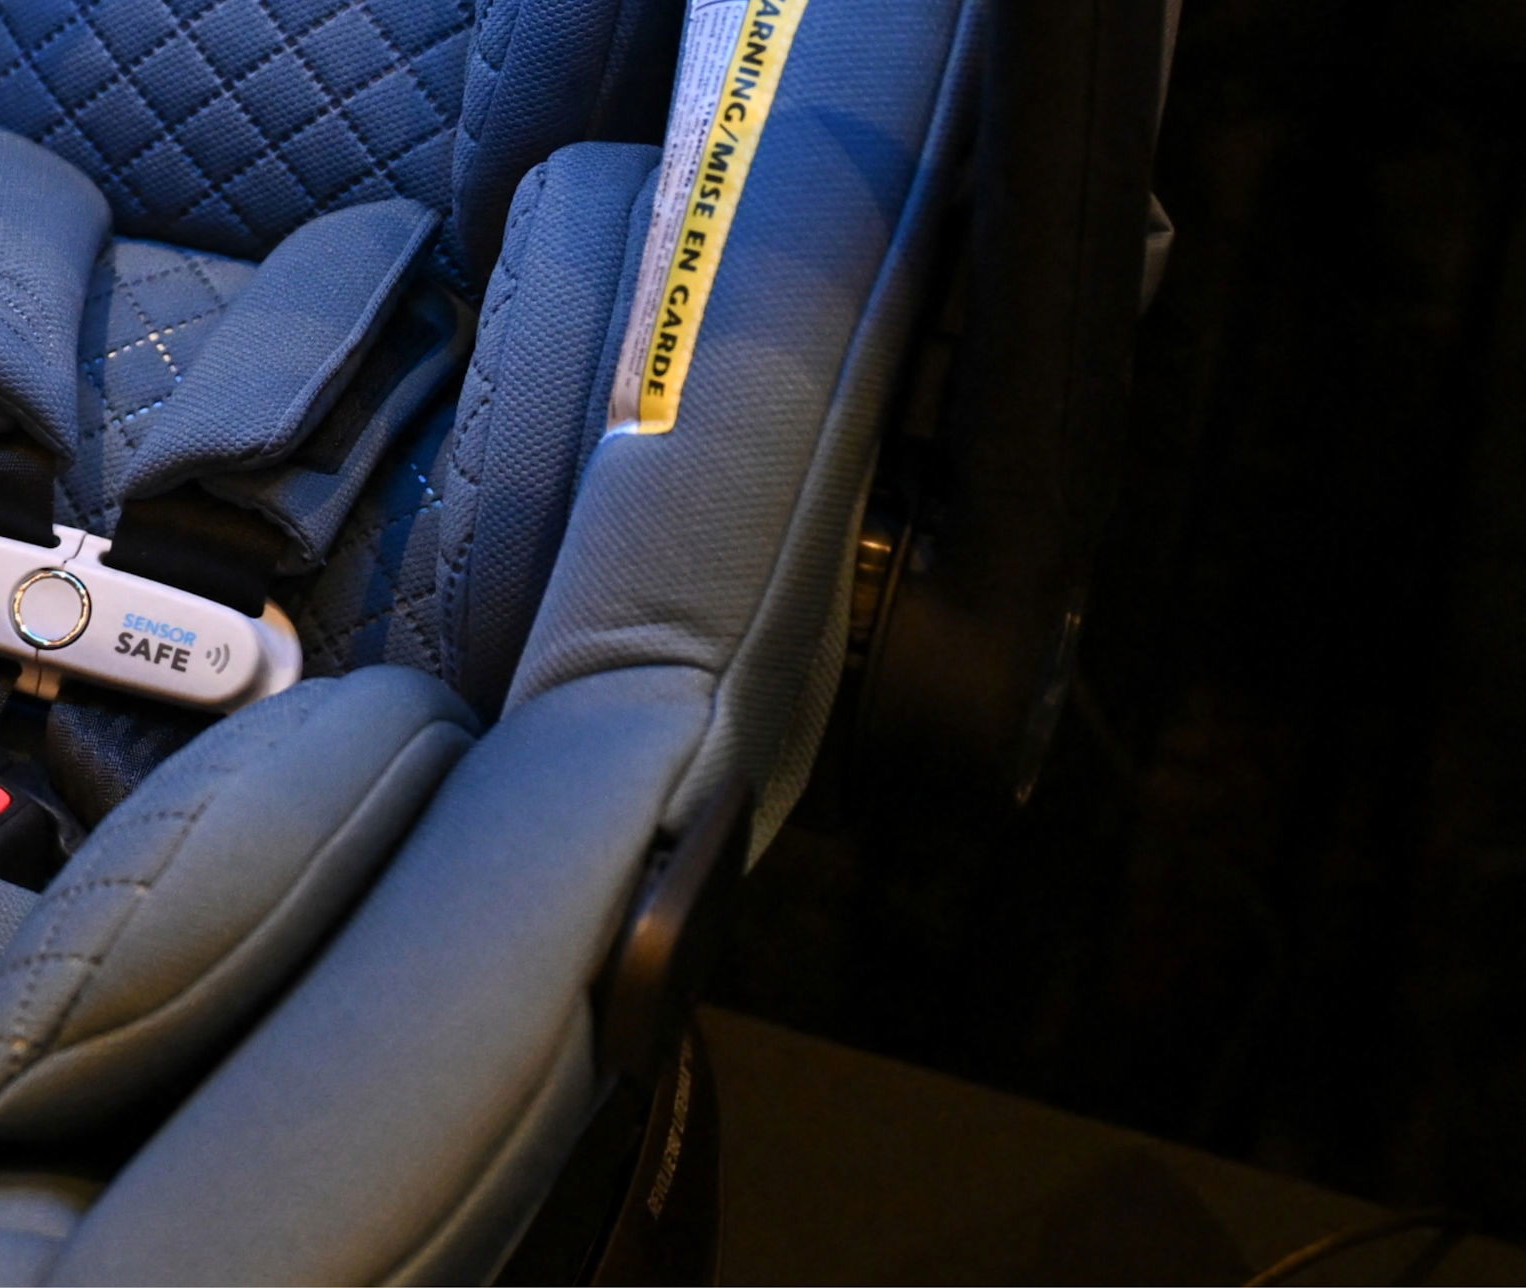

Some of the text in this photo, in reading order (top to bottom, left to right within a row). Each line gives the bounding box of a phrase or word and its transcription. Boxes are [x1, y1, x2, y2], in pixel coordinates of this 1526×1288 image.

[678, 229, 707, 273] EN
[647, 284, 690, 398] GARDE
[122, 613, 197, 647] SENSOR
[114, 632, 192, 673] SAFE
